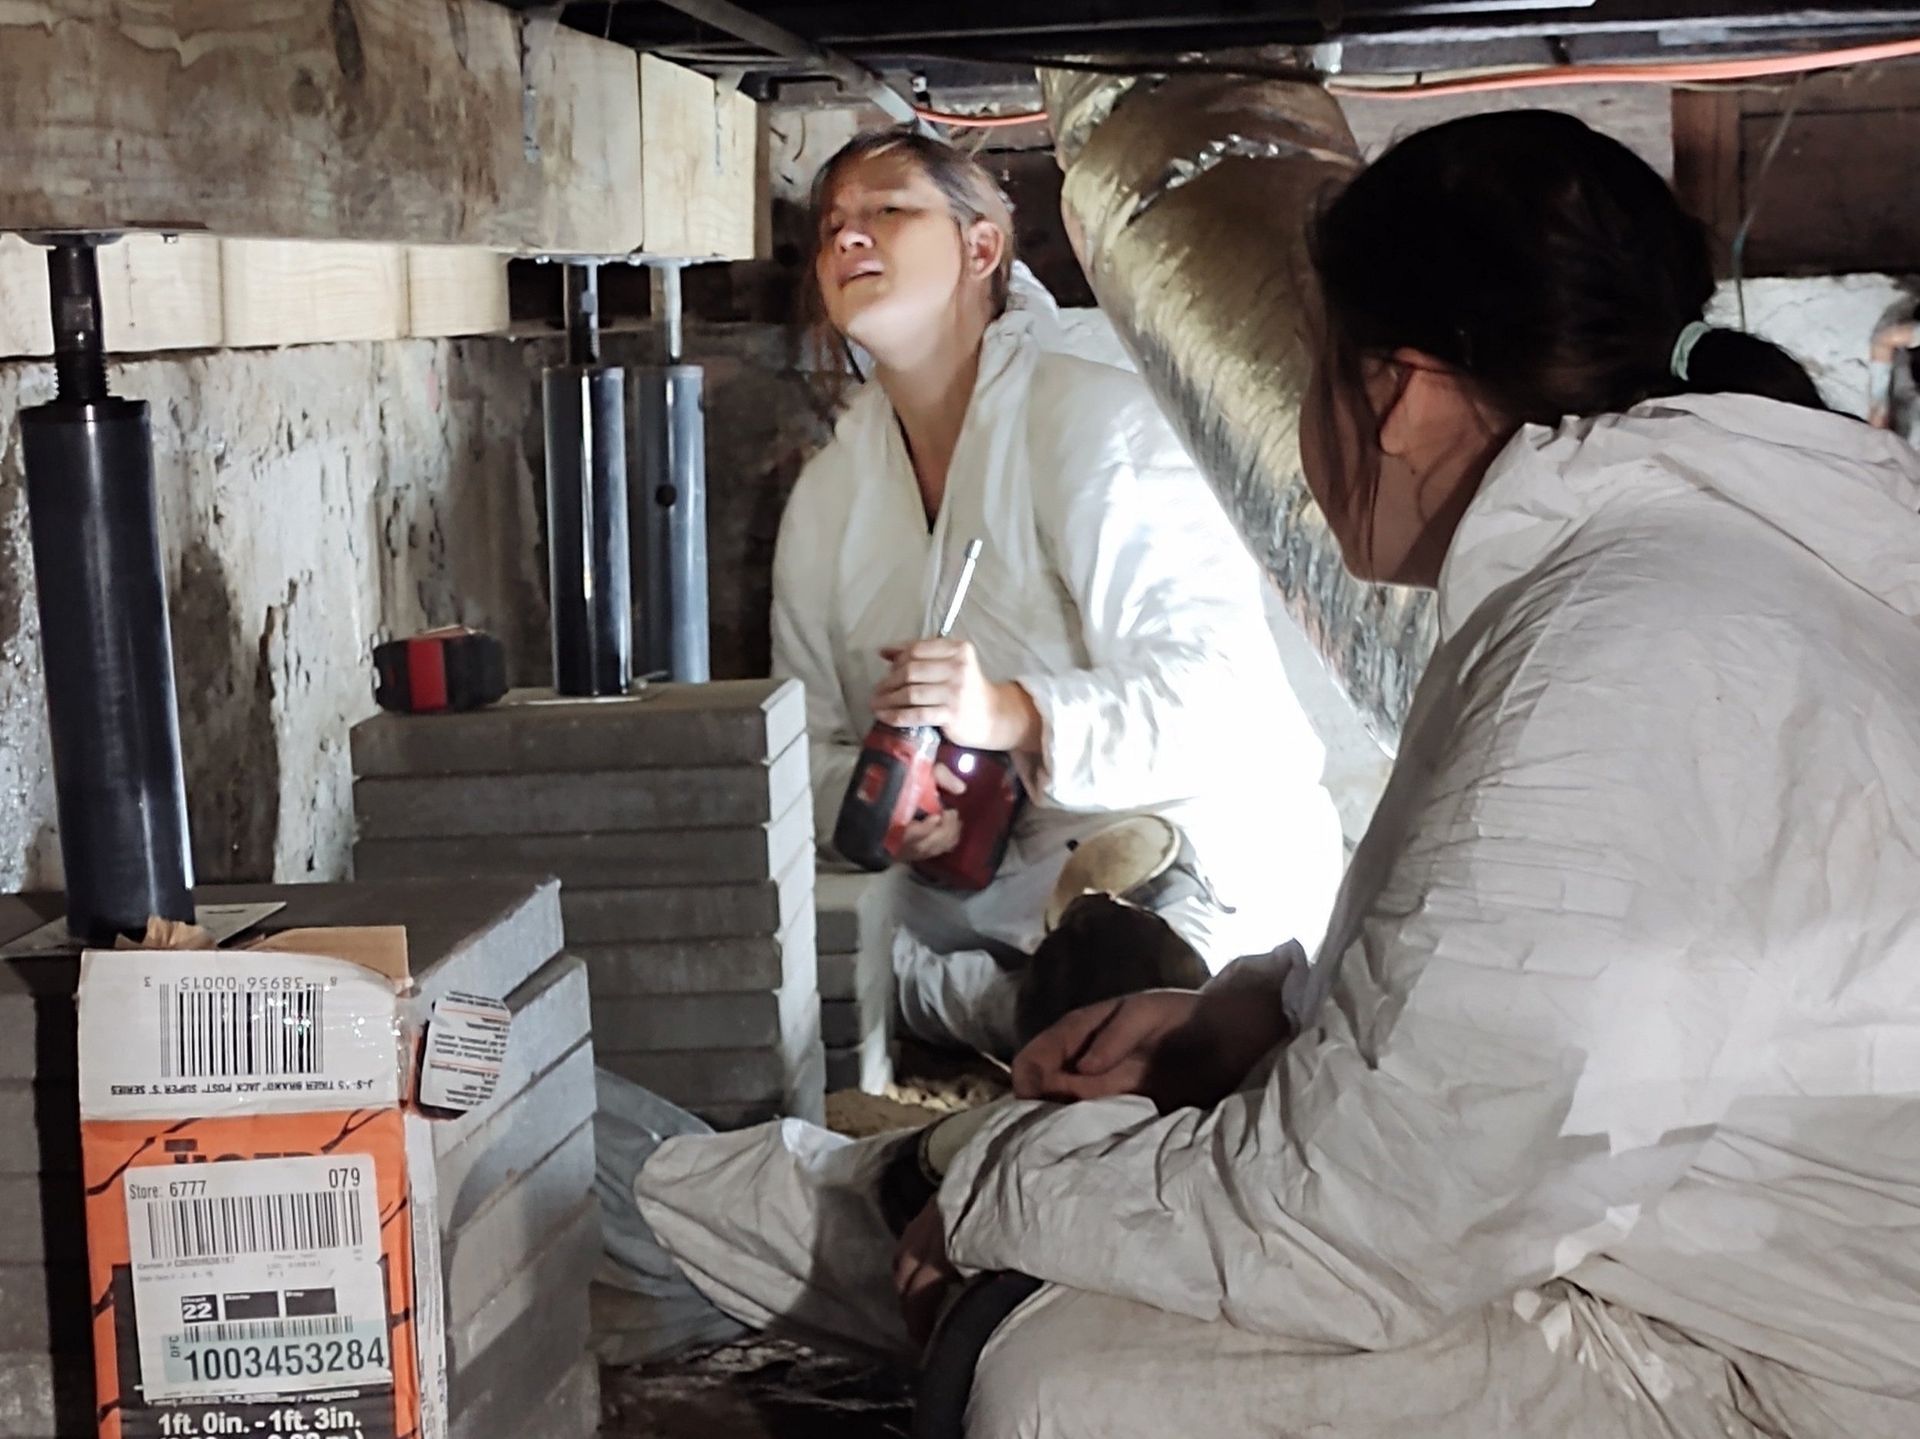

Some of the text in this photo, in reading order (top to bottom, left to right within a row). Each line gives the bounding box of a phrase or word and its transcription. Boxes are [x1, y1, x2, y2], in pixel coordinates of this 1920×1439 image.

[144, 976, 151, 987] 3
[180, 976, 237, 991] 00015
[247, 976, 304, 991] 38956
[111, 1085, 146, 1096] SERIES
[165, 1084, 198, 1095] SUPER
[236, 1082, 261, 1092] JACK
[306, 1080, 334, 1091] TIGER
[129, 1167, 361, 1200] Store: 6777 079
[182, 1303, 213, 1320] 22
[184, 1337, 384, 1382] 1003453284
[158, 1413, 198, 1435] 1ft.
[202, 1411, 250, 1434] 0in.
[268, 1409, 310, 1433] 1ft.
[314, 1406, 362, 1430] 3in.
